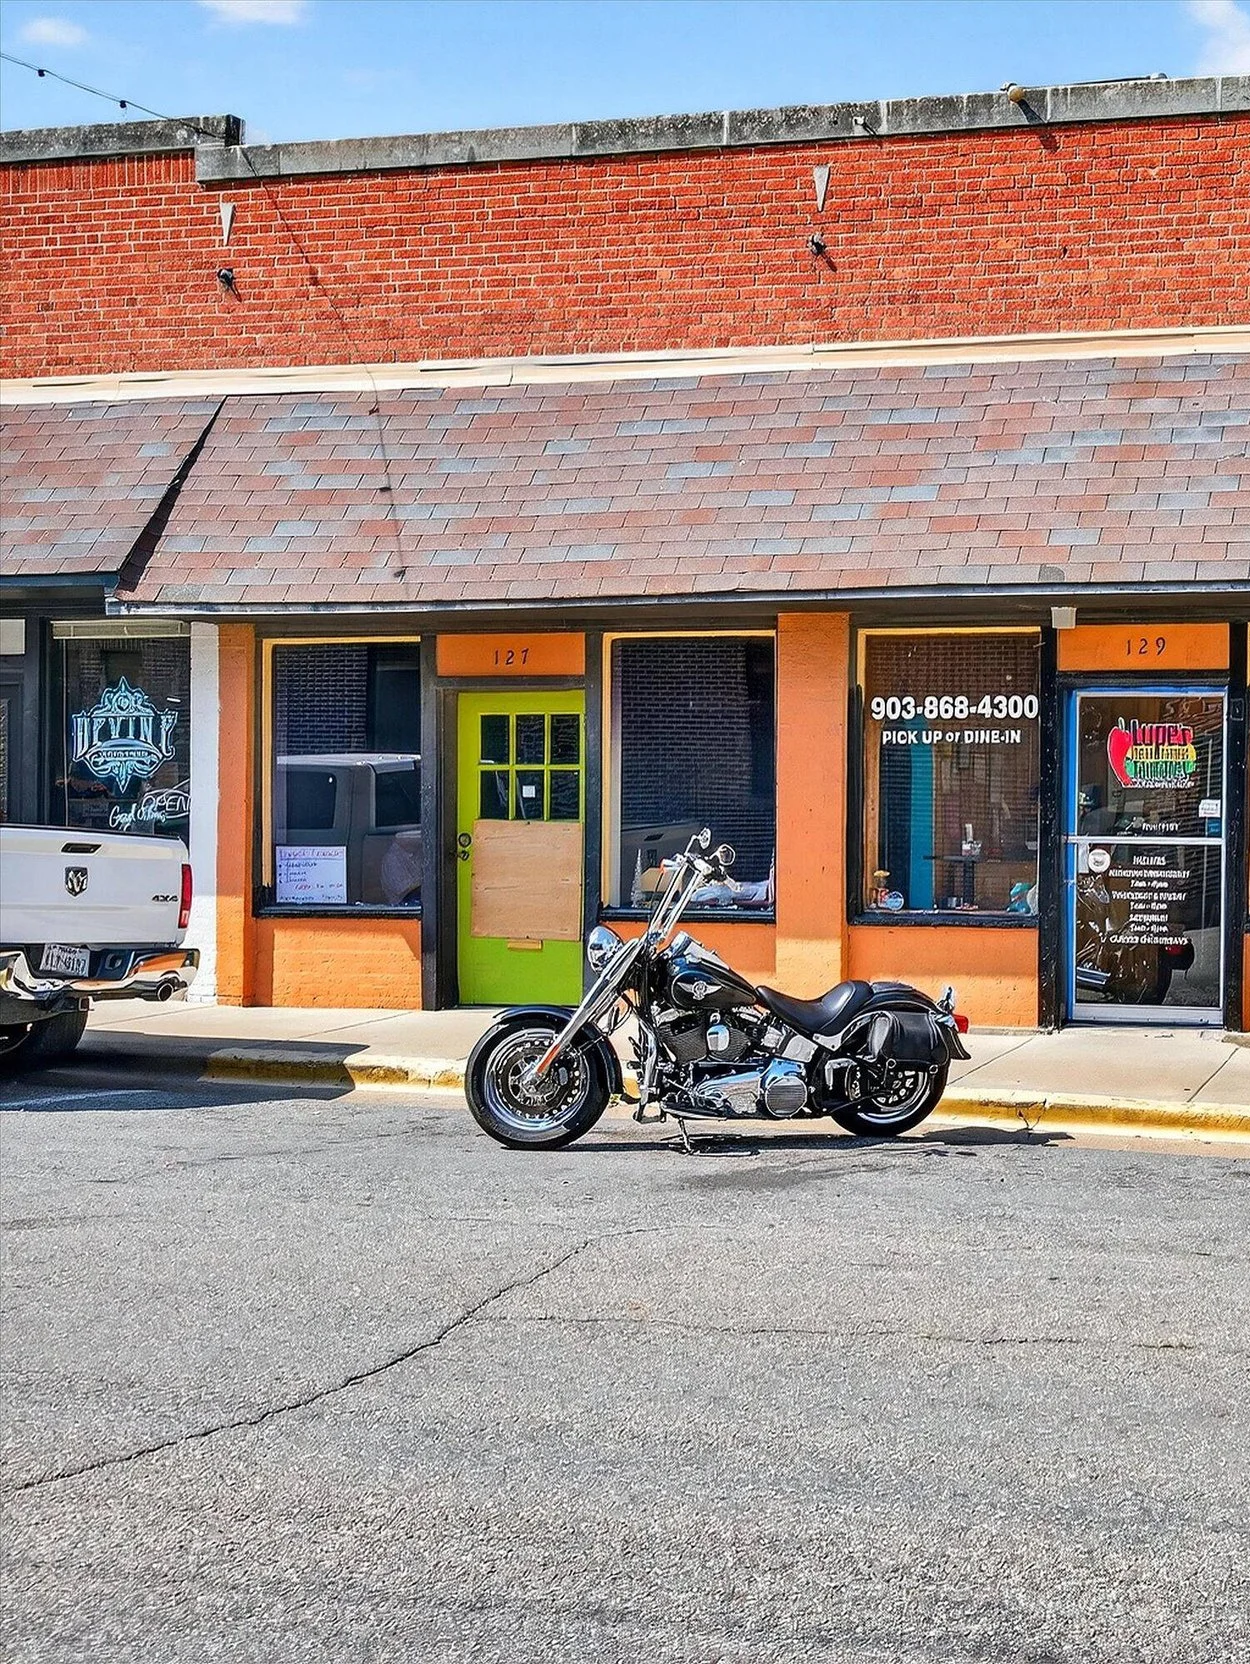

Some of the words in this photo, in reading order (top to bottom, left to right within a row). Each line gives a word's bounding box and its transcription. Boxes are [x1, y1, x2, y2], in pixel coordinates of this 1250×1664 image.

[1126, 637, 1166, 656] 129
[494, 648, 529, 666] 127
[871, 695, 1039, 720] 903-868-4300
[882, 730, 918, 745] PICK
[922, 730, 943, 744] UP
[945, 731, 960, 743] or
[964, 729, 1021, 745] DINE-IN
